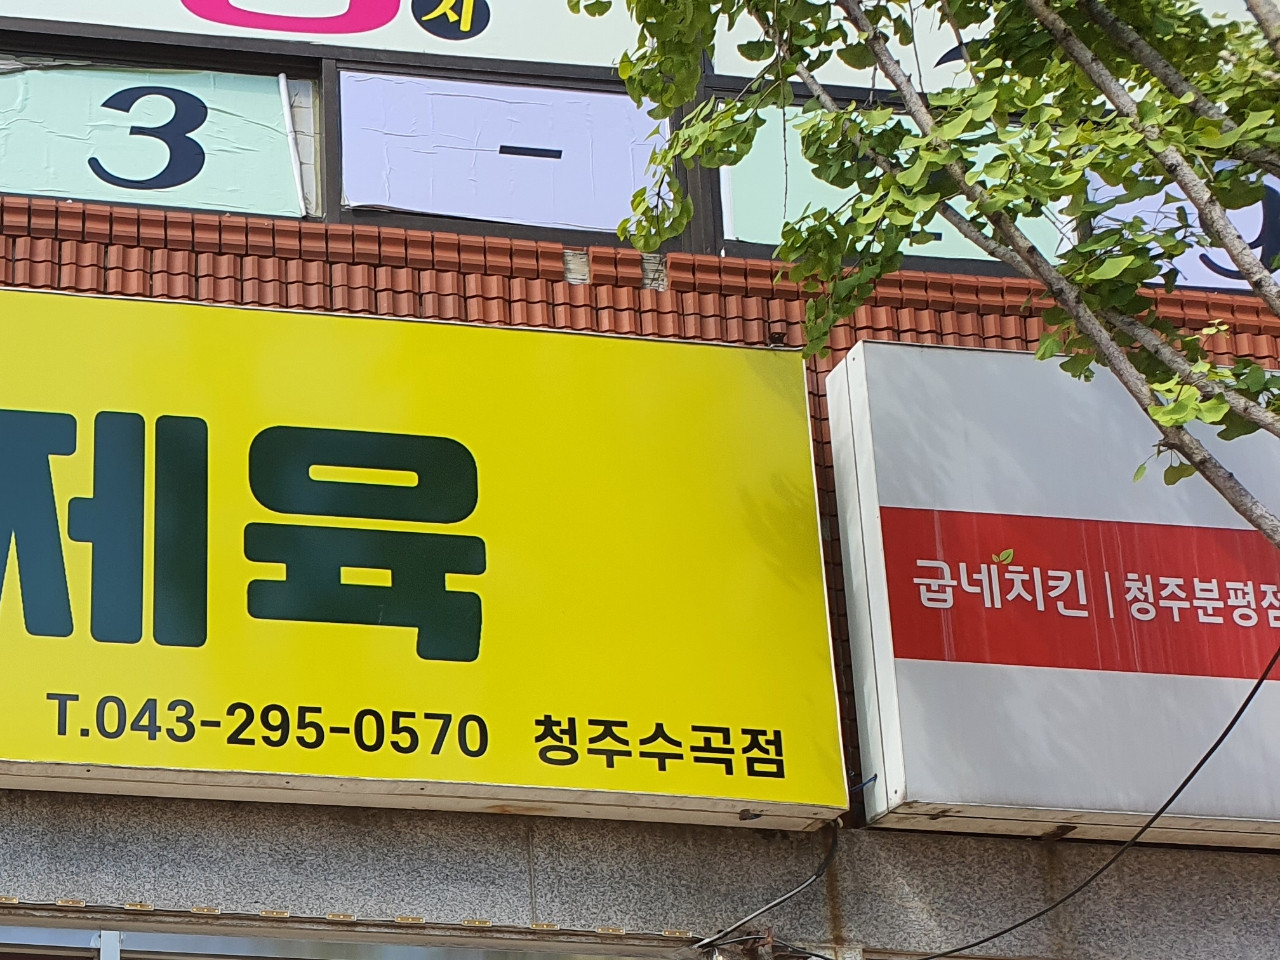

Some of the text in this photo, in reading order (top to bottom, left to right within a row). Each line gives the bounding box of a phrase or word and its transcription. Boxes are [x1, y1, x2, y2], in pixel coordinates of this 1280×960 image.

[87, 86, 208, 190] 3
[913, 558, 1089, 618] 굽네치킨
[534, 714, 785, 780] 청주수곡점
